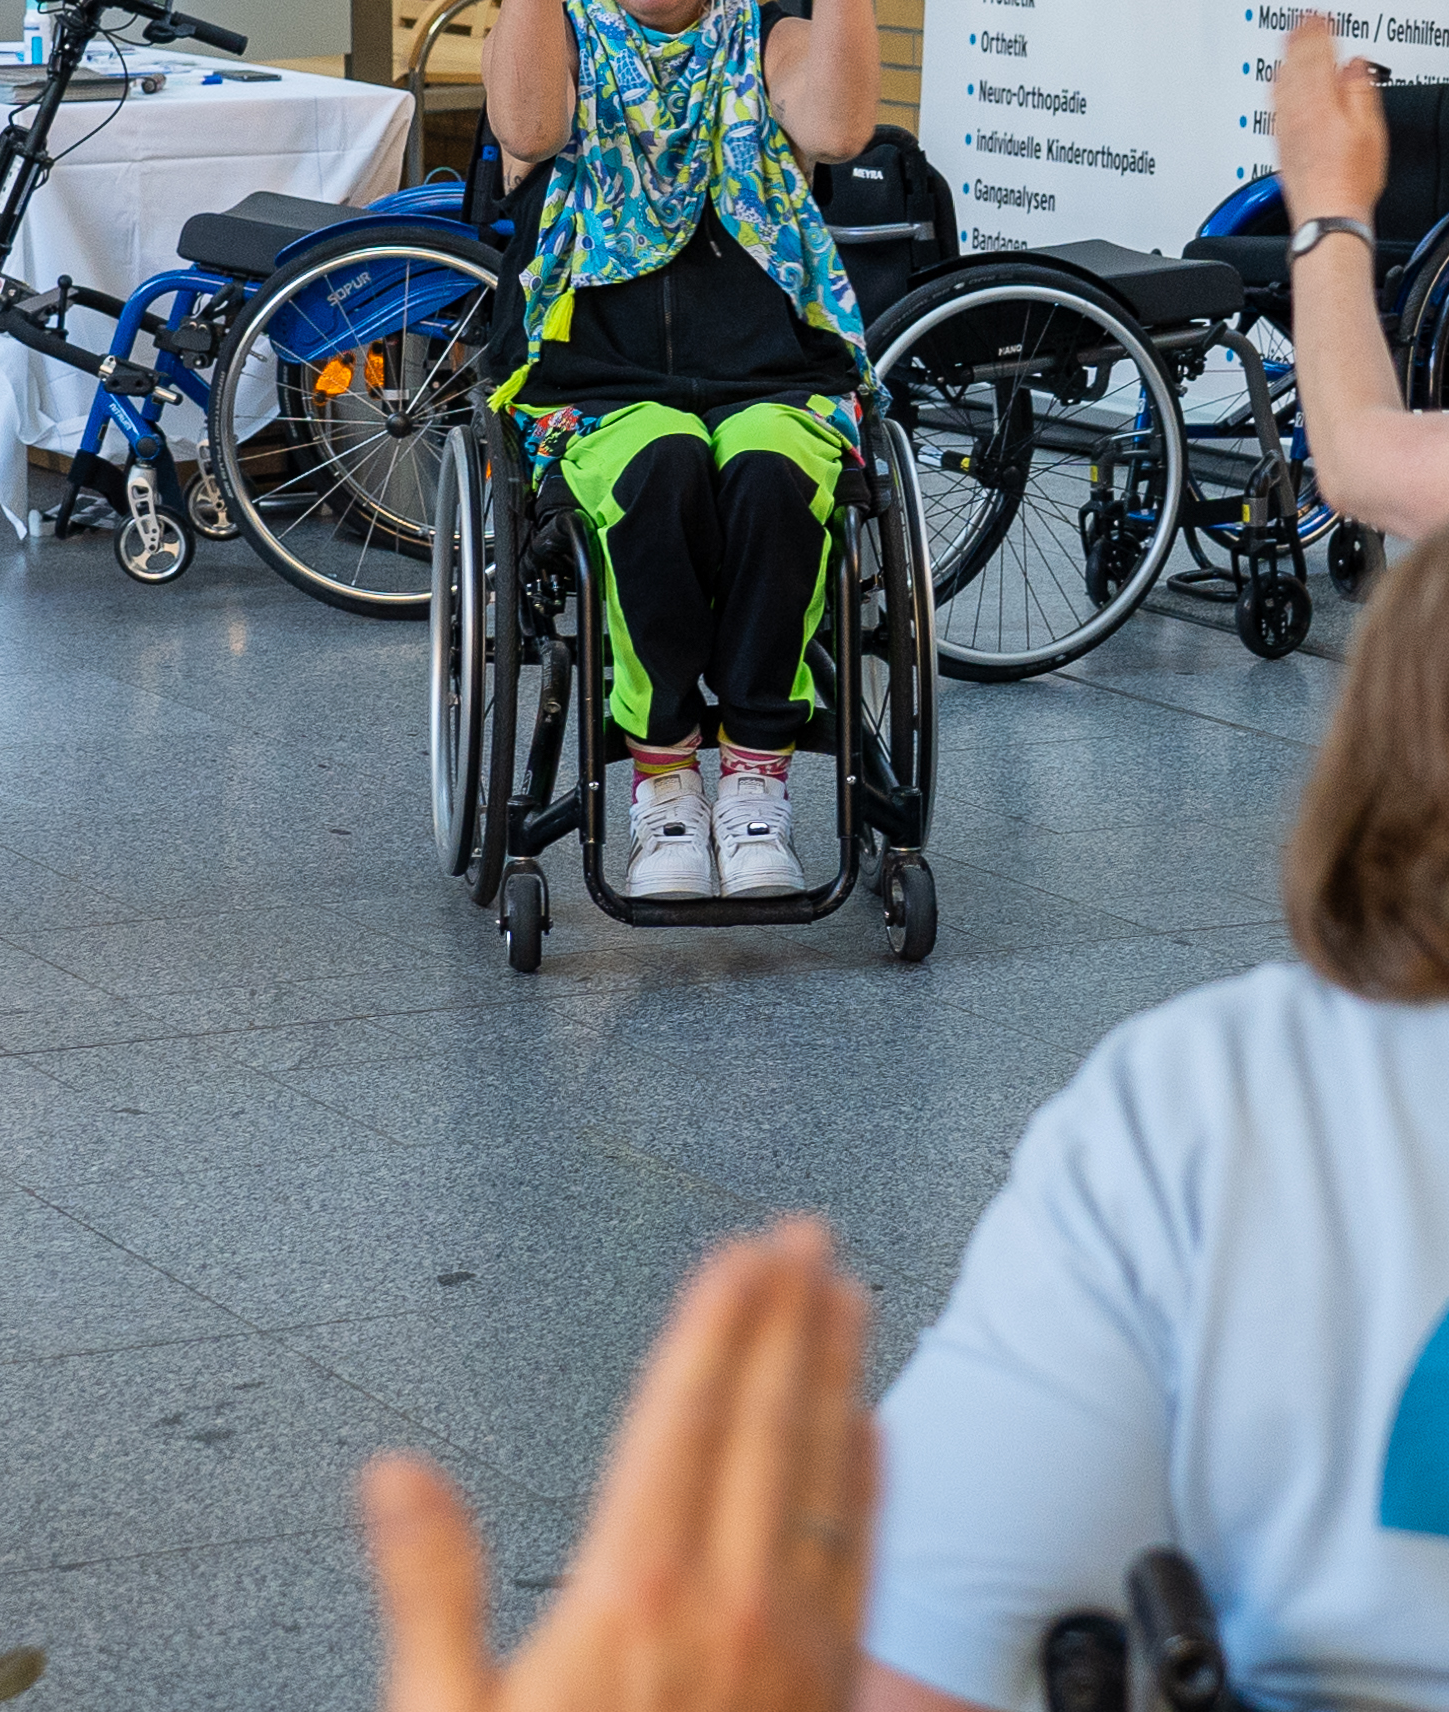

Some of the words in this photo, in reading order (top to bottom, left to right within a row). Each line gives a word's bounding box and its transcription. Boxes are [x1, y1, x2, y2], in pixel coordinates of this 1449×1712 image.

[980, 31, 1028, 58] Orthetik
[1387, 17, 1449, 48] Gehhilfen
[978, 79, 1087, 116] Neuro-Orthopädie
[976, 129, 1041, 161] individuelle
[1046, 138, 1156, 176] Kinderorthopädie
[973, 179, 1056, 214] Ganganalysen
[327, 271, 371, 307] SOPUR
